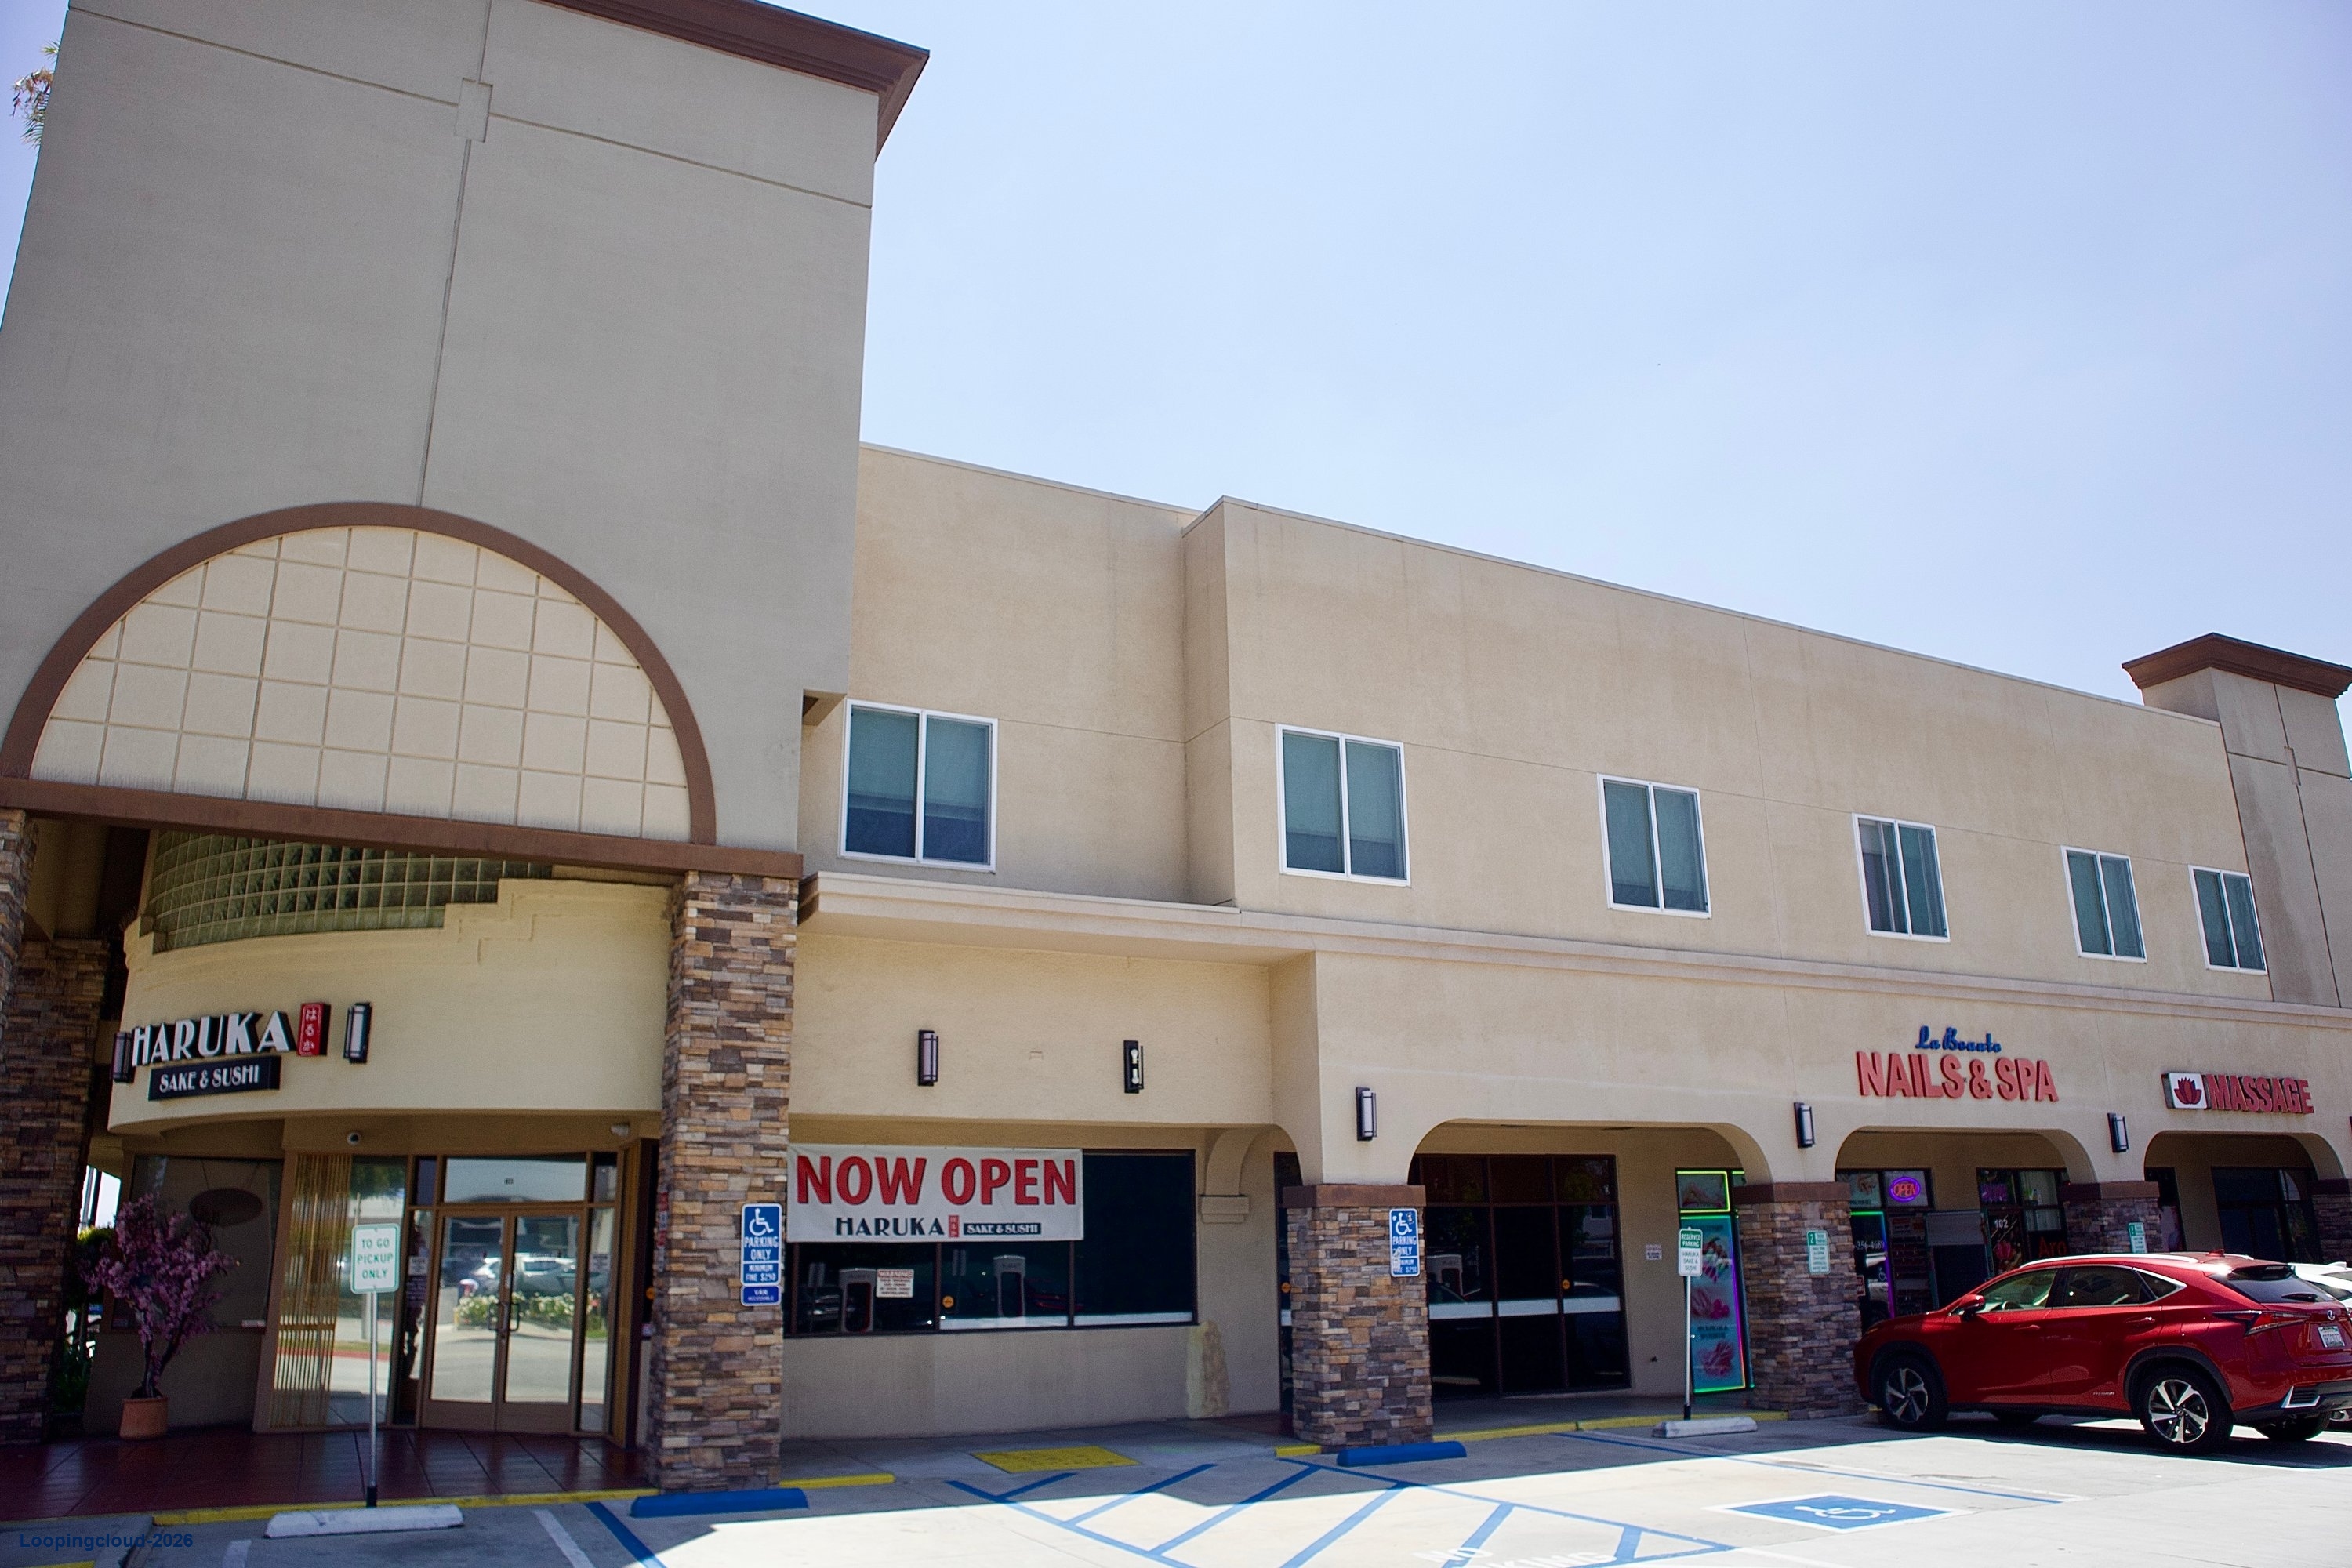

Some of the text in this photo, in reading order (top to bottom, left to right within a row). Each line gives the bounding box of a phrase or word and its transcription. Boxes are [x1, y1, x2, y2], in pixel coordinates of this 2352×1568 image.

[132, 1011, 291, 1067] HARUKA
[158, 1064, 260, 1093] SAKE & SUSHI
[1856, 1051, 2060, 1102] NAILS & SPA
[2205, 1073, 2314, 1114] MASSAGE
[797, 1155, 1076, 1206] NOW OPEN
[1893, 1182, 1917, 1197] OPEN
[835, 1217, 945, 1237] HARUKA
[967, 1224, 1038, 1234] SAKE & SUSHI
[1994, 1218, 2009, 1229] 102
[362, 1238, 390, 1249] TO GO
[744, 1236, 779, 1248] PARKING
[1392, 1236, 1417, 1246] PARKING
[357, 1253, 393, 1264] PICKUP
[750, 1249, 771, 1261] ONLY
[361, 1269, 388, 1279] ONLY
